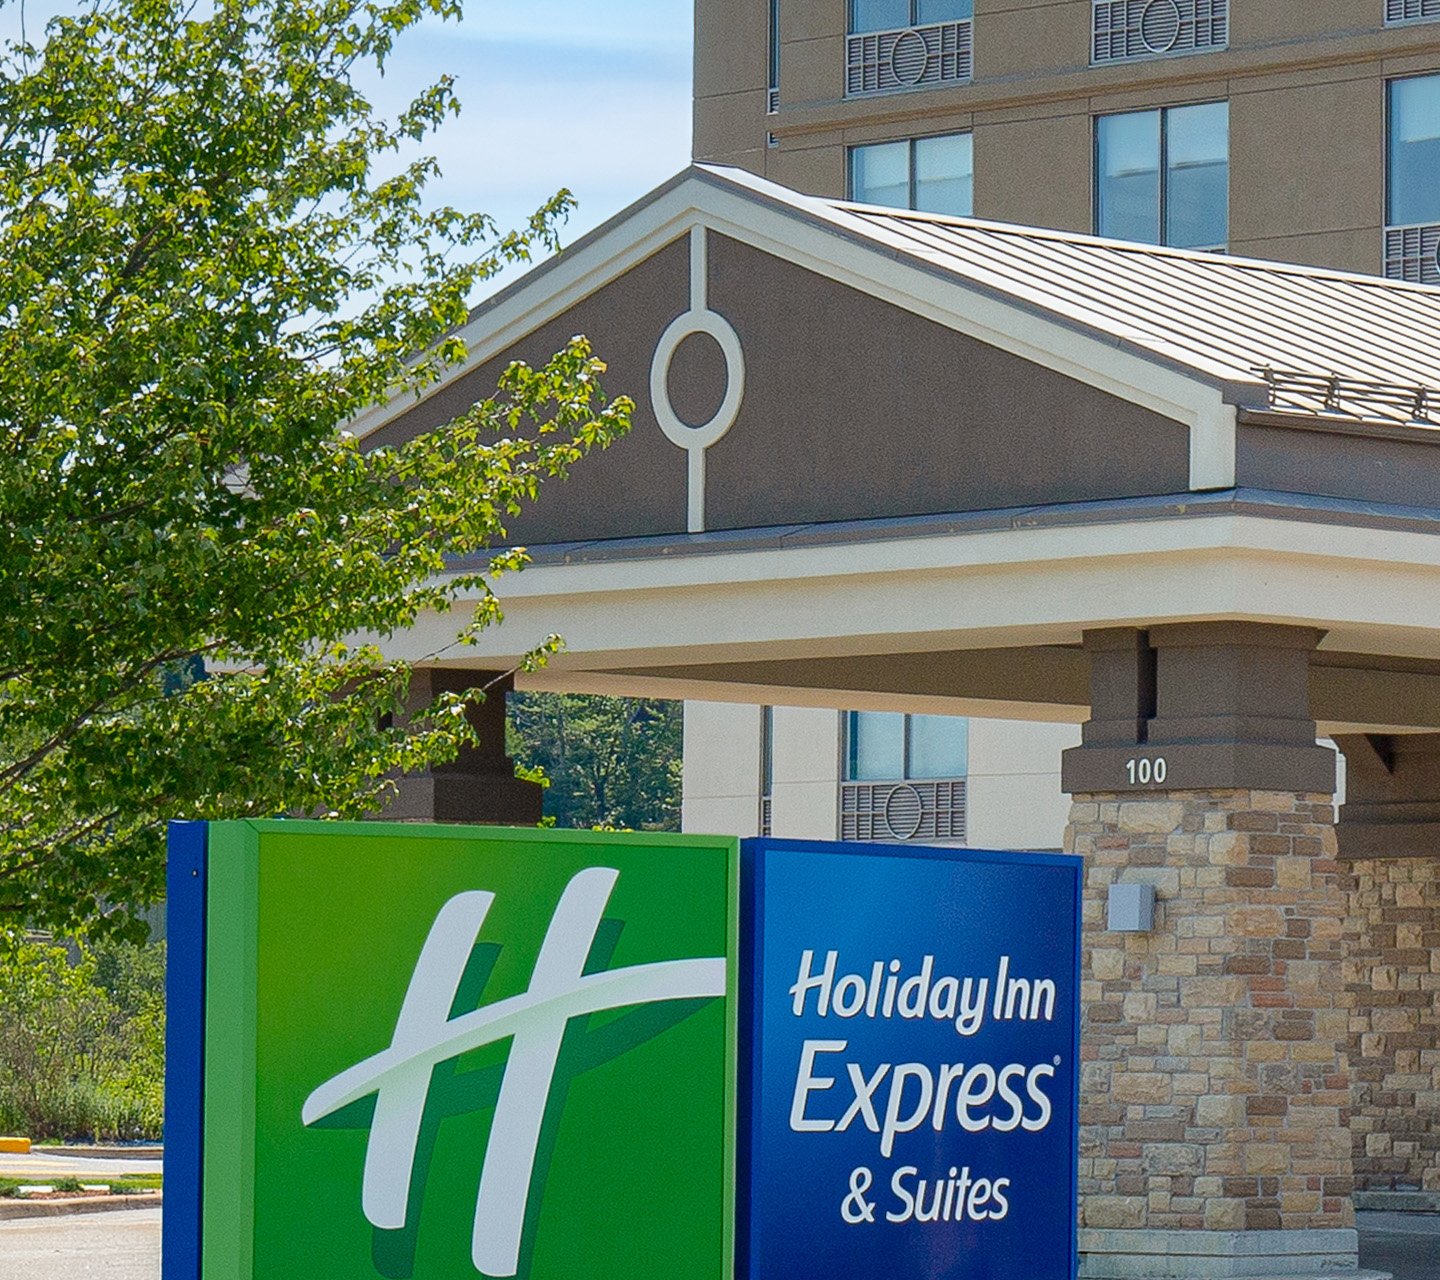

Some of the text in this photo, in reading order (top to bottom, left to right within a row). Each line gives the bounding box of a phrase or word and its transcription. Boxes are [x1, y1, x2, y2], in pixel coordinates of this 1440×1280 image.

[1126, 757, 1167, 785] 100
[789, 950, 1056, 1036] Holiday Inn
[789, 1039, 1055, 1158] Express
[840, 1166, 1010, 1224] & Suites
